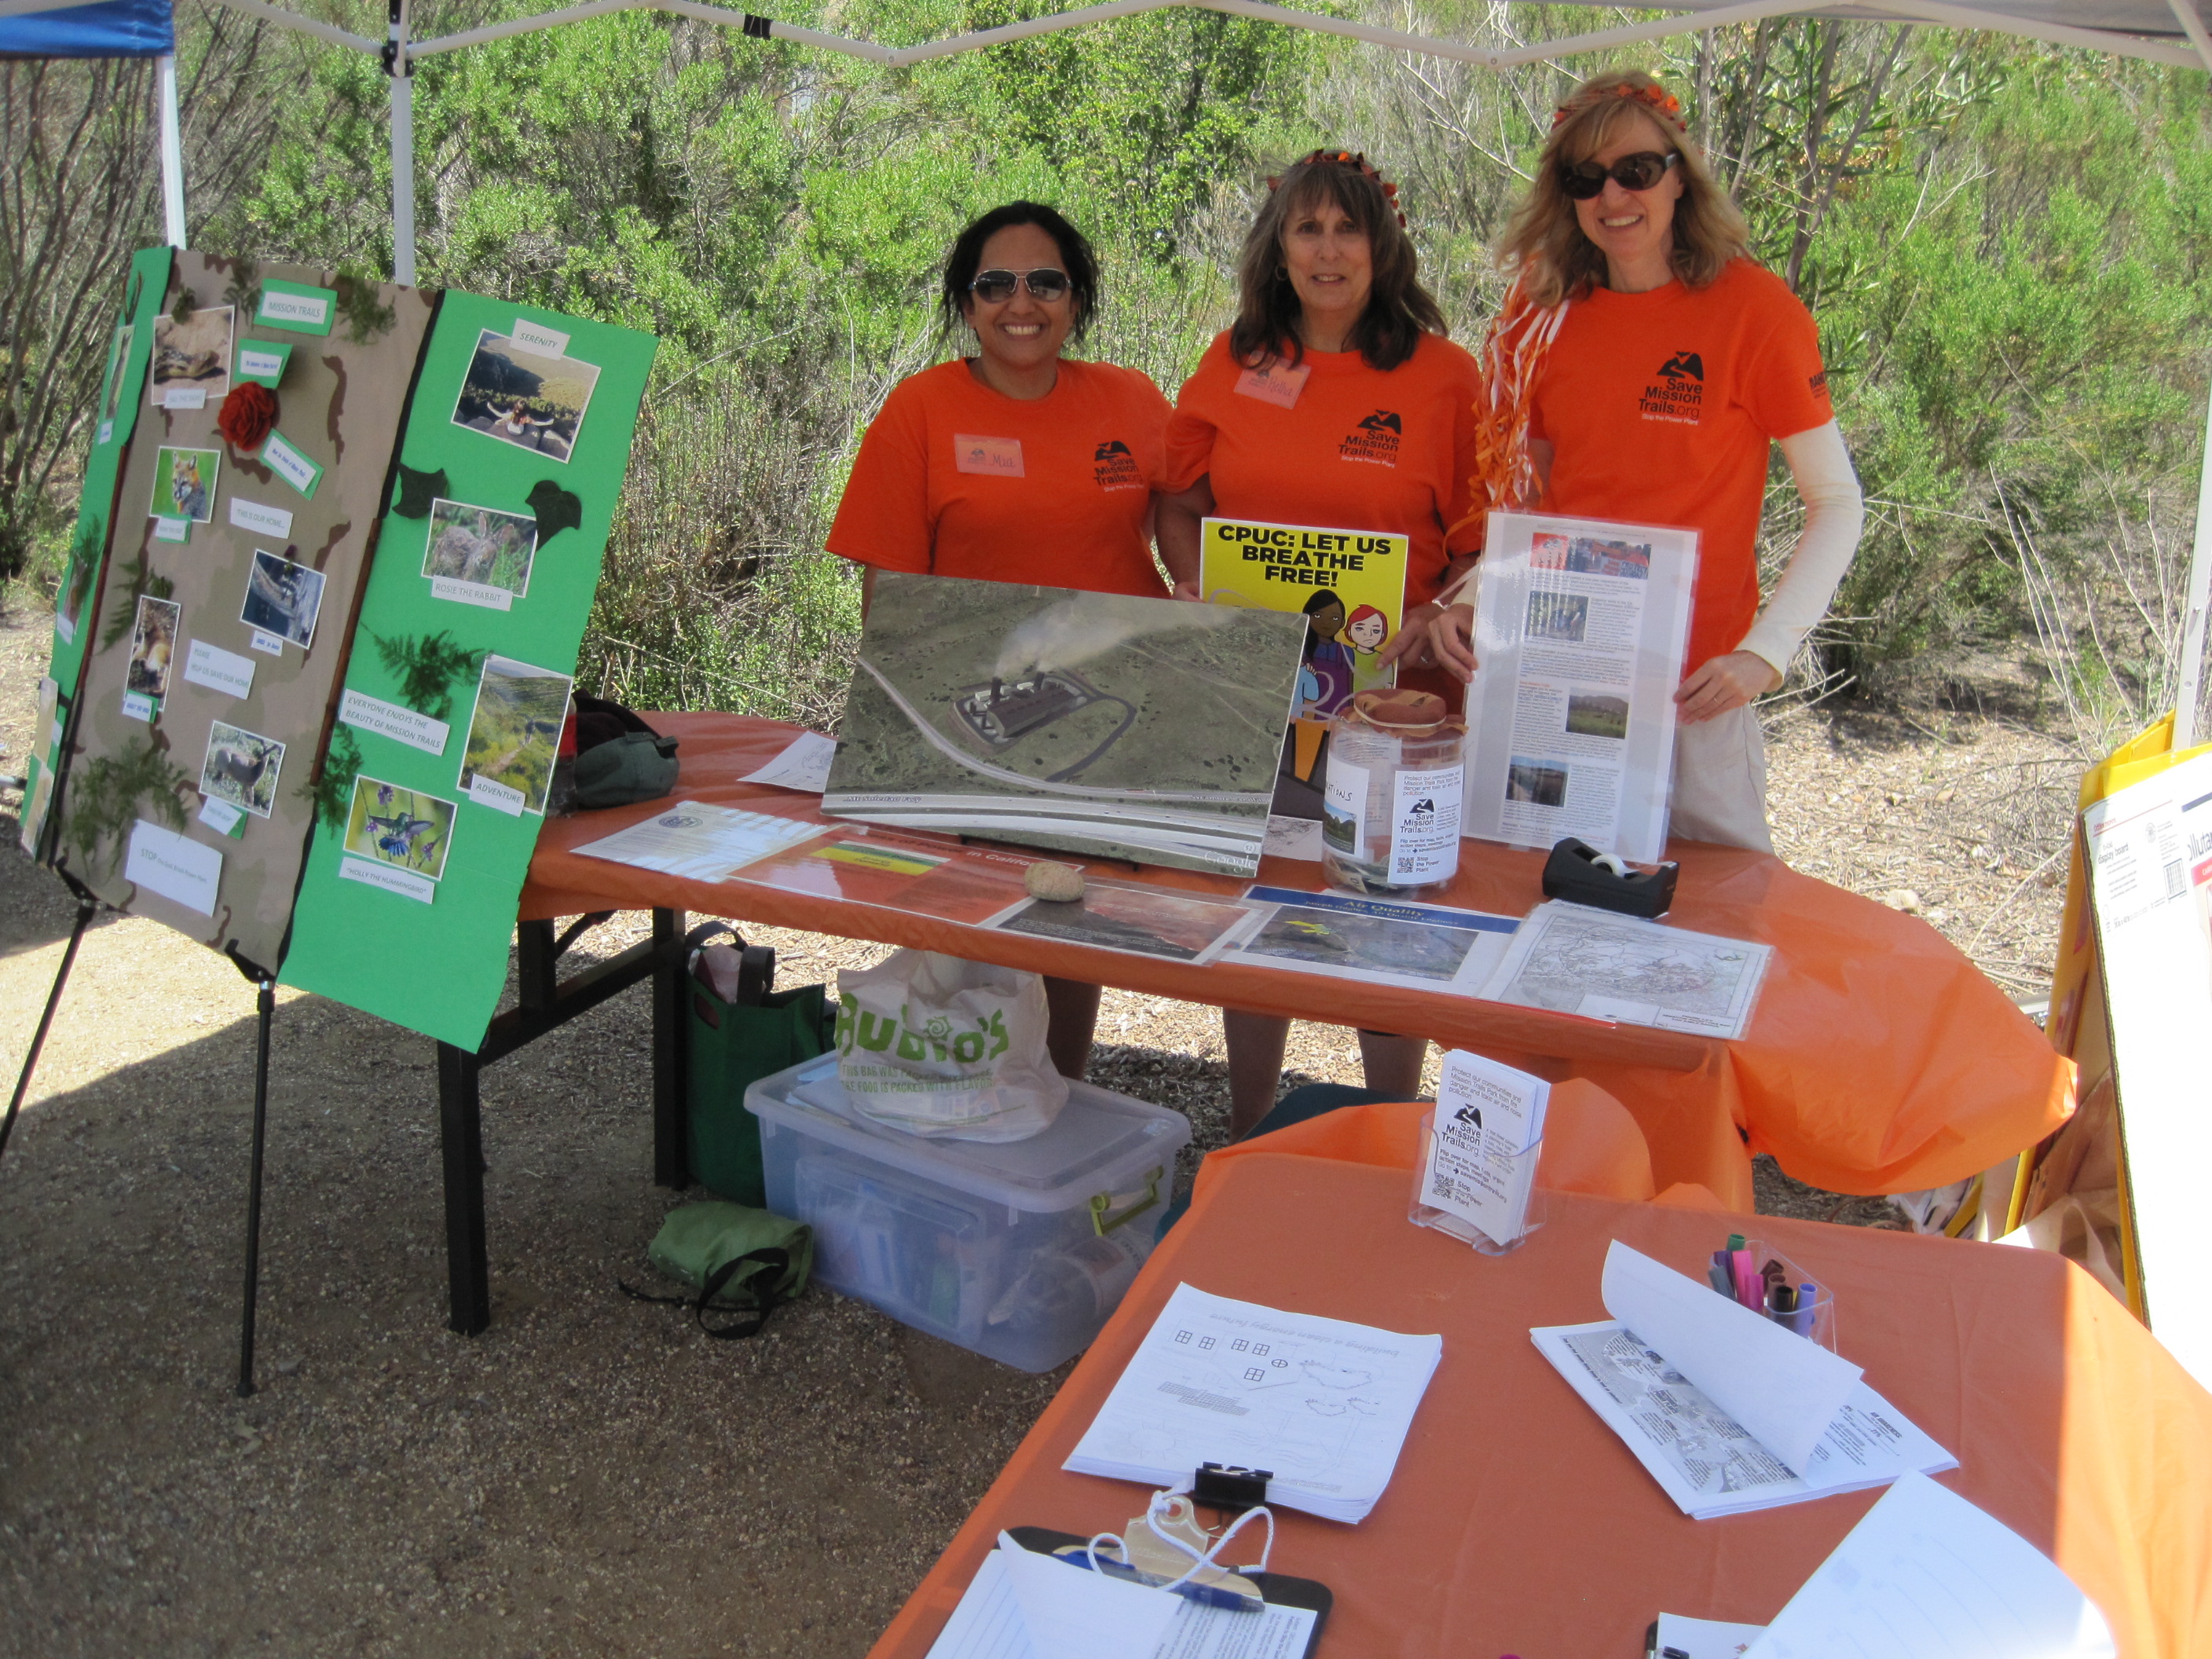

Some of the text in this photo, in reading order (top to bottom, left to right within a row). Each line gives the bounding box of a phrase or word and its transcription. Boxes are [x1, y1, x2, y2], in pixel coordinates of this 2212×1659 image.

[269, 302, 320, 317] MISSION TRAILS
[519, 332, 558, 348] SERENITY
[1666, 377, 1703, 394] Save
[1645, 386, 1702, 405] Mission
[1639, 398, 1700, 420] Trails.org
[1346, 435, 1398, 452] Mission
[1367, 430, 1400, 445] Save
[1338, 445, 1397, 463] Trails.org
[1094, 465, 1139, 476] Mission
[1093, 474, 1144, 485] Trails.org
[1218, 525, 1391, 555] CPUC: LET US
[1242, 544, 1364, 571] BREATHE
[1265, 565, 1339, 587] FREE!
[435, 584, 501, 602] ROSIE THE RABBIT
[211, 669, 223, 679] SAVE
[347, 697, 429, 729] EVERYONE ENJOYS THE
[346, 709, 441, 749] BEAUTY OF MISSION TRAILS
[476, 783, 521, 804] ADVENTURE
[141, 848, 157, 860] STOP
[2098, 842, 2129, 864] display board
[1204, 851, 1258, 873] Google
[370, 873, 380, 881] THE
[1371, 905, 1424, 917] Quality
[842, 1064, 859, 1077] THIS
[860, 1065, 877, 1077] BAG
[878, 1066, 896, 1077] WAS
[840, 1080, 855, 1092] THE
[857, 1082, 878, 1093] FOOD
[881, 1082, 889, 1093] IS
[891, 1082, 924, 1093] PACKED
[927, 1082, 952, 1091] WITH
[1448, 1086, 1471, 1099] pollution
[1451, 1072, 1471, 1085] Mission
[1487, 1087, 1498, 1097] Park
[1452, 1066, 1471, 1078] Protect
[1512, 1094, 1521, 1103] and
[1449, 1080, 1469, 1090] danger
[1500, 1102, 1509, 1111] and
[1446, 1124, 1480, 1146] Mission
[1460, 1122, 1481, 1138] Save
[1440, 1148, 1449, 1157] Flip
[1441, 1132, 1479, 1157] Trails.org
[1457, 1181, 1470, 1192] Stop
[1455, 1196, 1470, 1207] Plant
[1209, 1313, 1249, 1328] future
[1251, 1320, 1296, 1335] energy
[1298, 1332, 1333, 1344] clean
[1345, 1339, 1400, 1357] building
